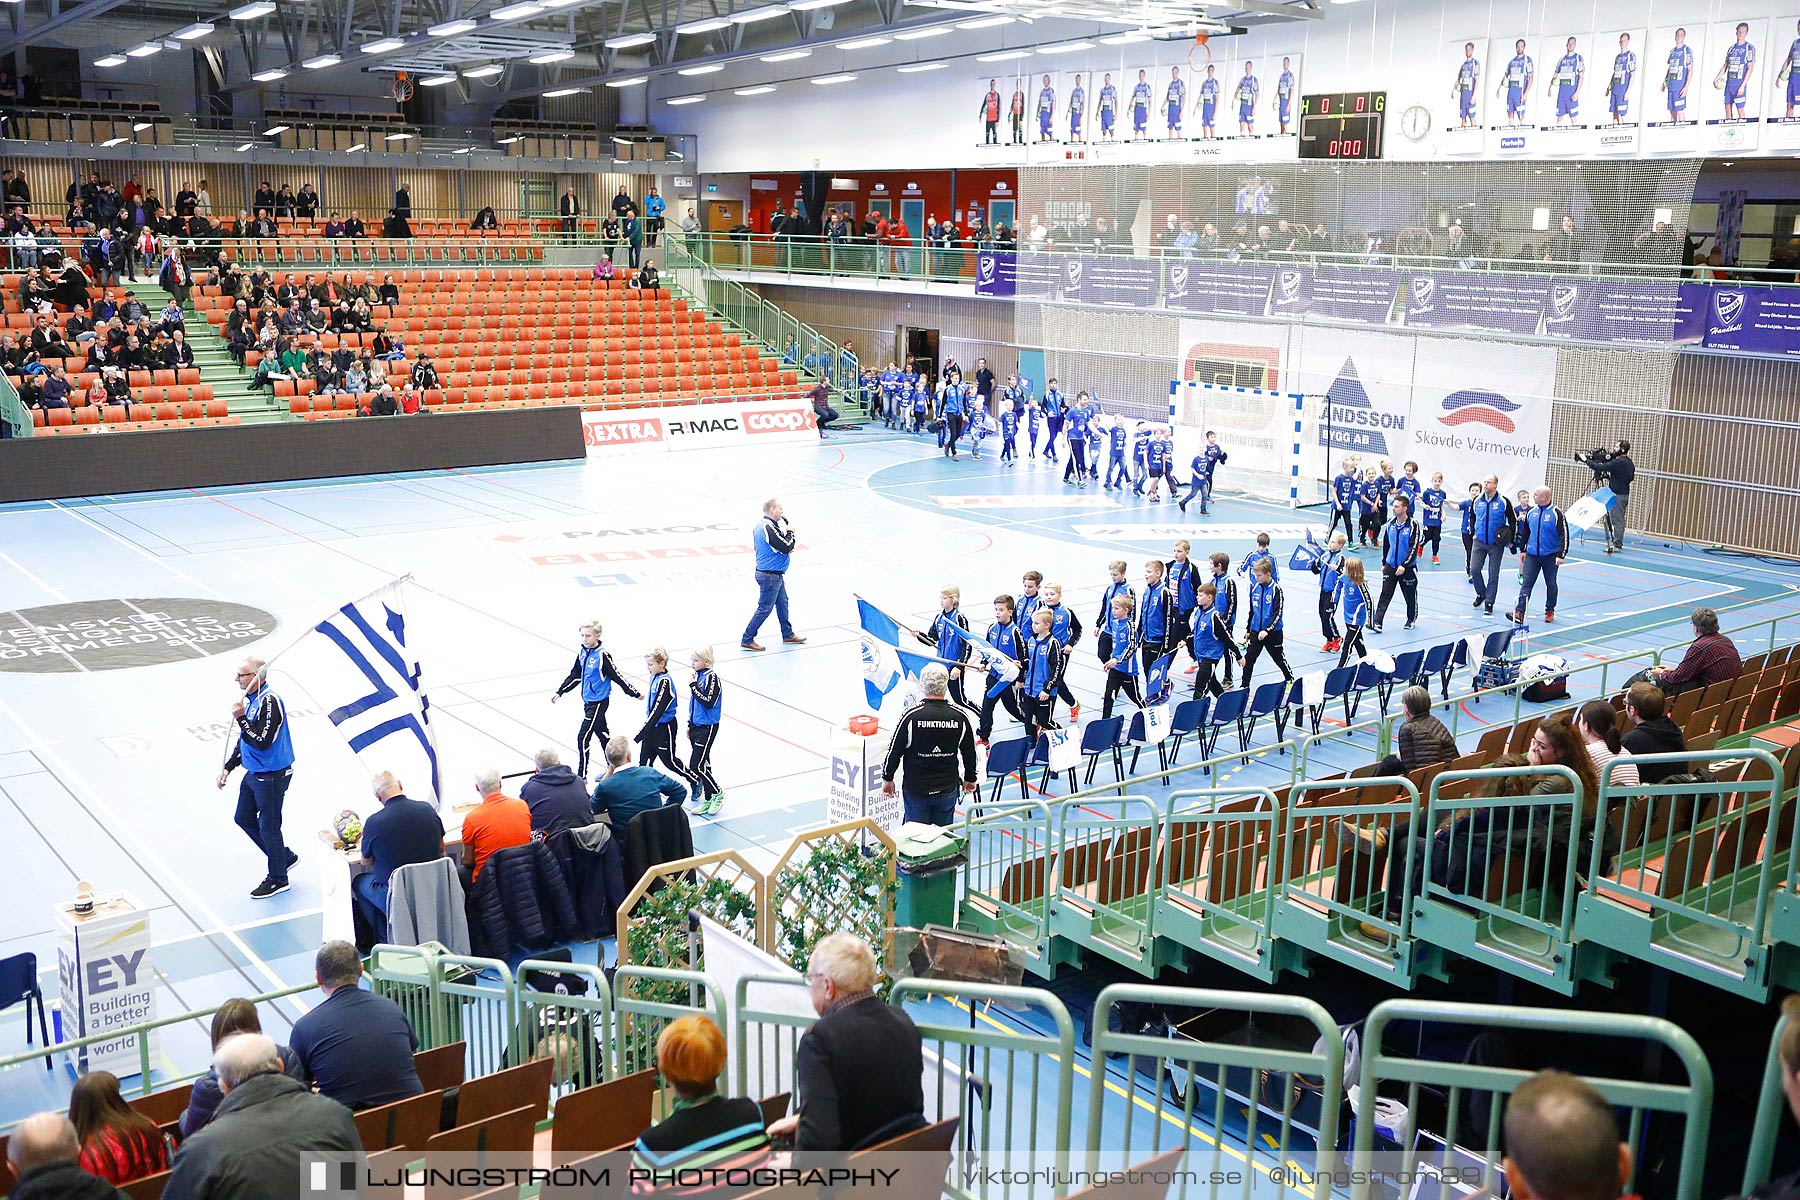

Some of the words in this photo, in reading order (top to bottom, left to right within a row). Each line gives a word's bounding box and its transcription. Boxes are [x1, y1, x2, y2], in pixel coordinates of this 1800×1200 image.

[1301, 100, 1310, 115] H
[1321, 98, 1330, 113] 0
[1356, 96, 1365, 112] 0
[1375, 96, 1385, 112] G
[594, 421, 659, 443] EXTRA
[1353, 432, 1370, 445] AB
[1414, 429, 1463, 449] Skövde
[1466, 436, 1541, 459] Värmeverk
[561, 523, 739, 541] PAROC
[917, 719, 959, 729] FUNKTIONÄR
[832, 755, 860, 789] EY
[831, 785, 860, 807] Building
[836, 798, 859, 815] better
[875, 800, 899, 815] better
[57, 946, 76, 993] EY
[86, 948, 147, 996] EY
[89, 991, 150, 1015] Building
[91, 1018, 100, 1029] a
[104, 1005, 150, 1026] better
[93, 1035, 135, 1056] world
